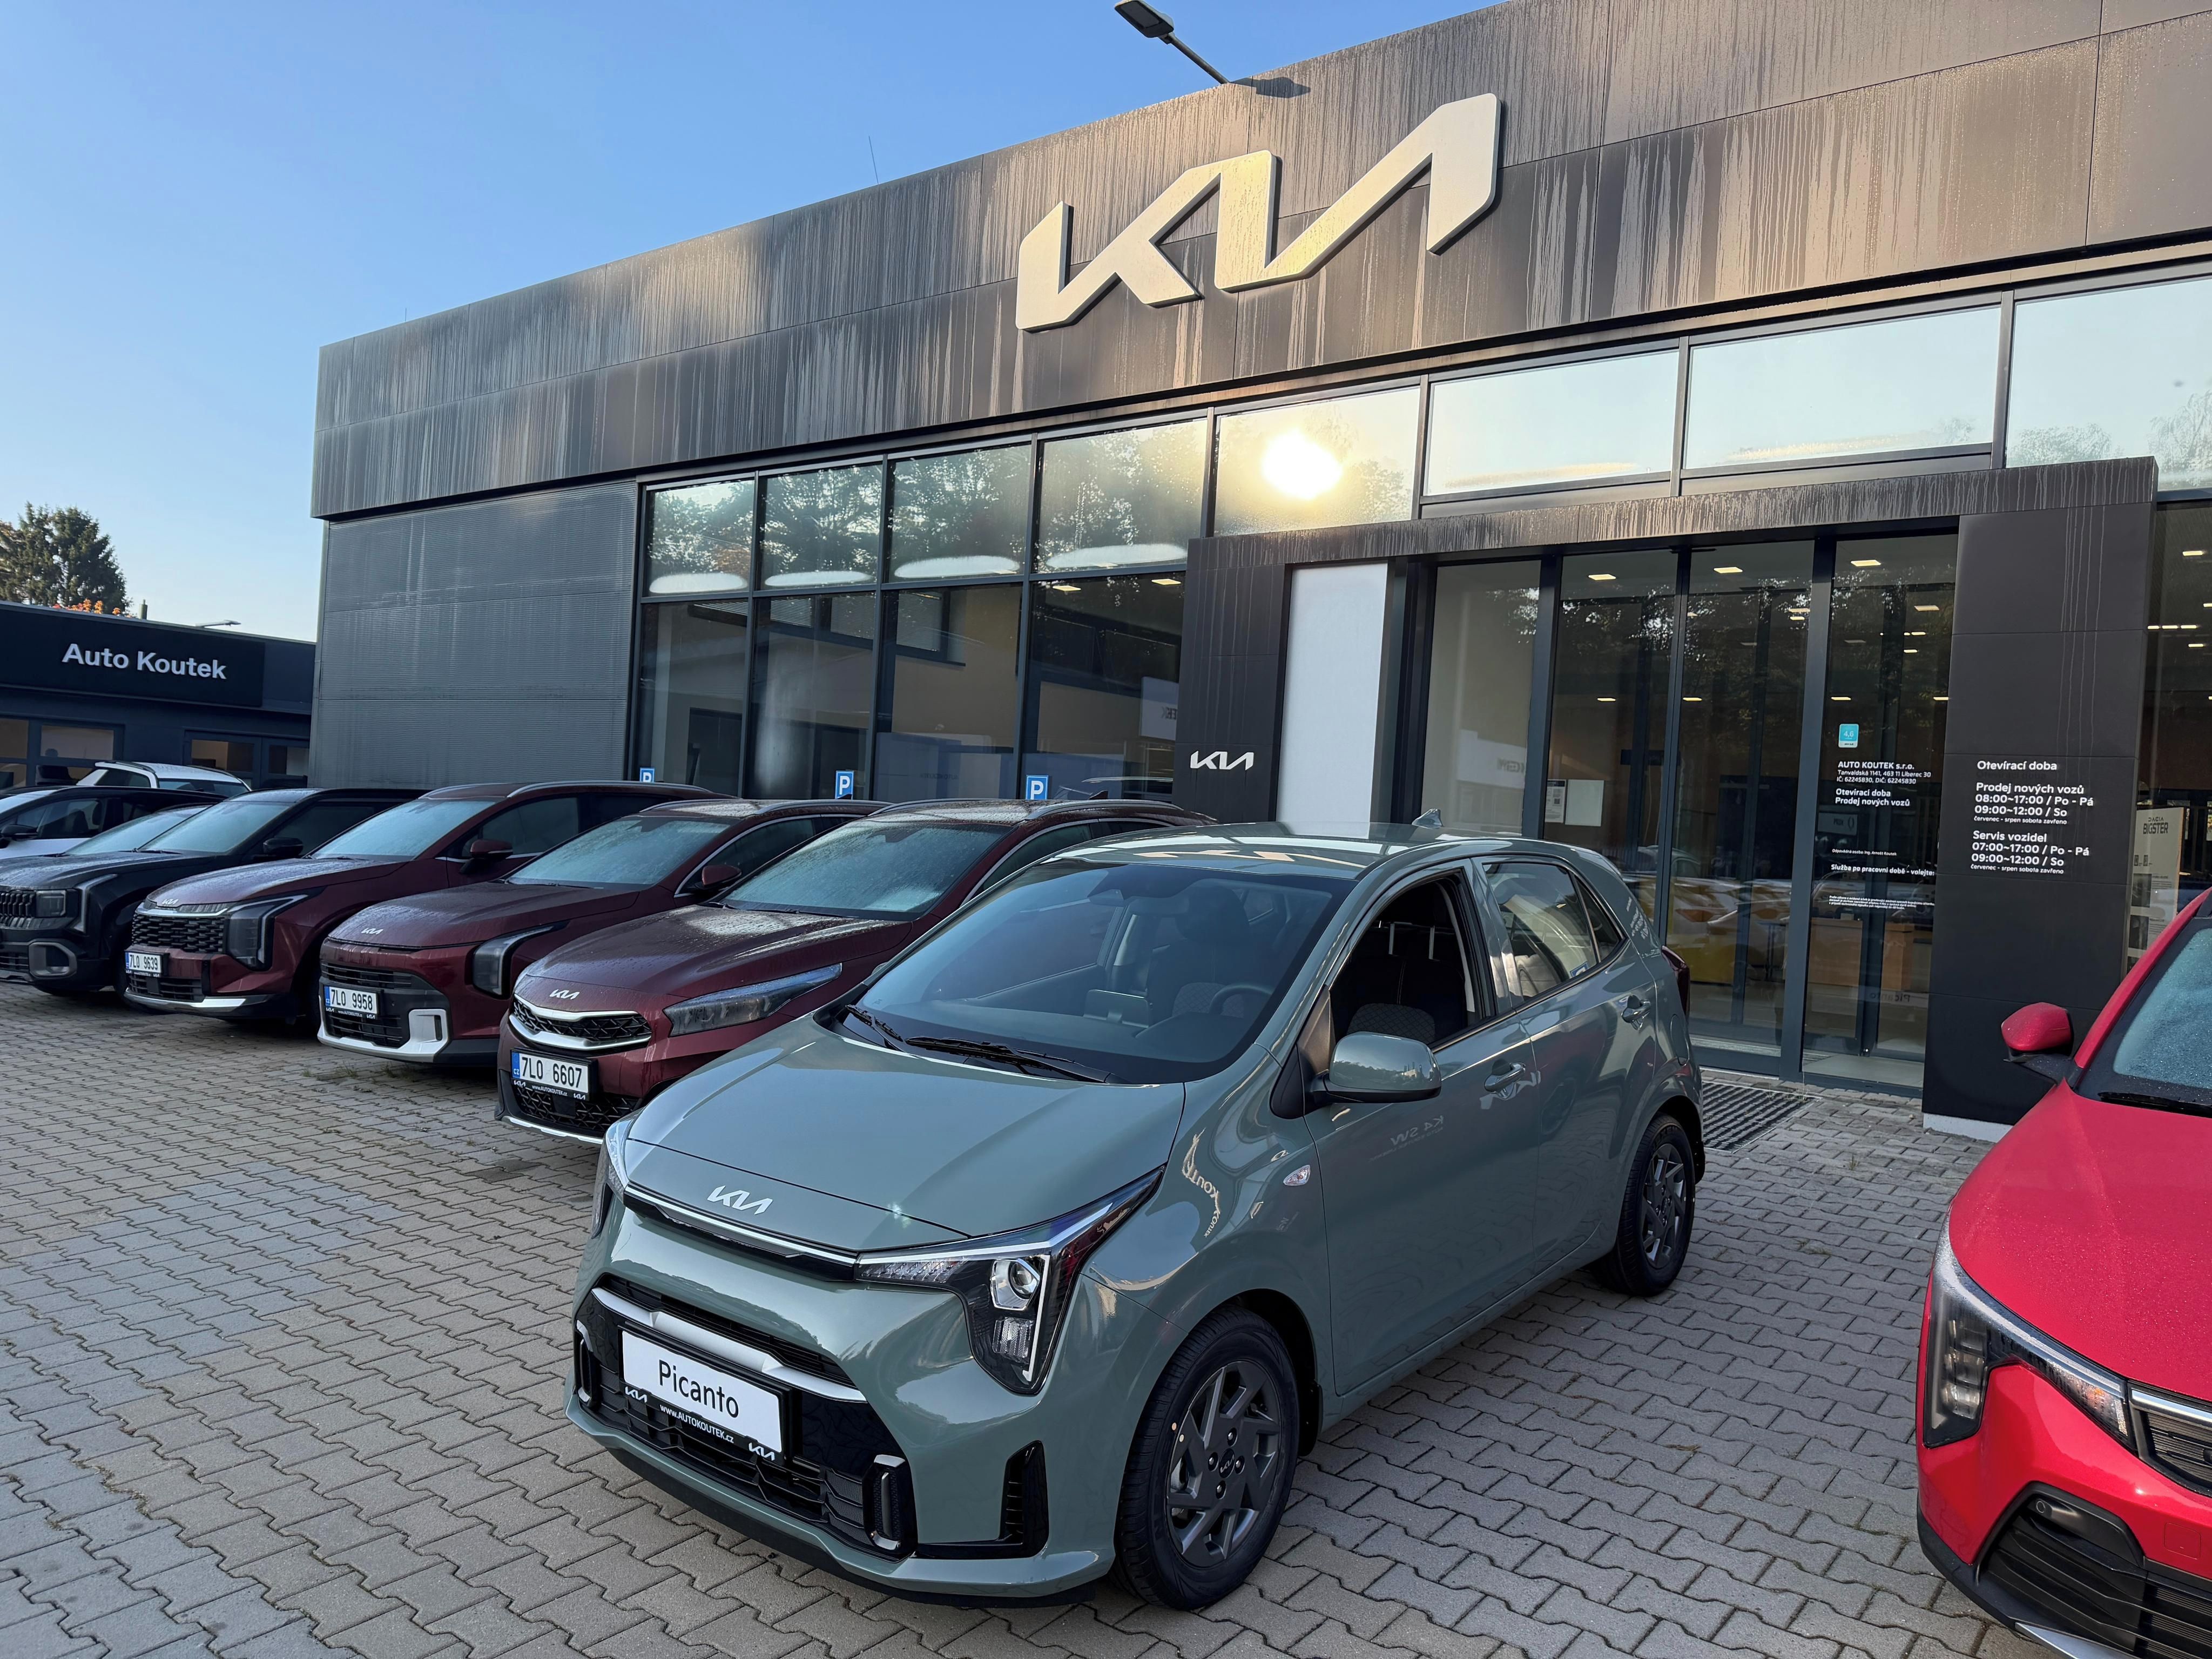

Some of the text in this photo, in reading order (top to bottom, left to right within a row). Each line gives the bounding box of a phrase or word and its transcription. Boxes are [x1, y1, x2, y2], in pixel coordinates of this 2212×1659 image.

[62, 643, 227, 679] Auto Koutek
[1838, 761, 1860, 769] AUTO
[1977, 760, 2057, 771] Otevírací doba
[839, 775, 850, 795] P
[1030, 780, 1044, 800] P
[1976, 782, 2084, 795] Prodej nových vozů
[1836, 788, 1891, 797] Otevírací doba
[1835, 797, 1860, 806] Prodej
[1862, 798, 1890, 807] nových
[1975, 794, 2044, 805] 08:00~17:00
[2054, 797, 2069, 806] Po
[2079, 796, 2094, 806] Pá
[1974, 805, 2043, 816] 09:00~12:00
[2053, 808, 2068, 817] So
[2142, 822, 2169, 834] BIGSTER
[1973, 831, 2047, 842] Servis vozidel
[1972, 842, 2040, 854] 07:00~17:00
[2050, 846, 2065, 855] Po
[2075, 846, 2090, 856] Pá
[1971, 853, 2040, 865] 09:00~12:00
[2050, 857, 2065, 866] So
[144, 956, 158, 970] 9639
[352, 993, 373, 1011] 9958
[552, 1063, 582, 1088] 6607
[658, 1359, 739, 1418] Picanto
[660, 1405, 734, 1444] www.AUTOKOUTEK.cz
